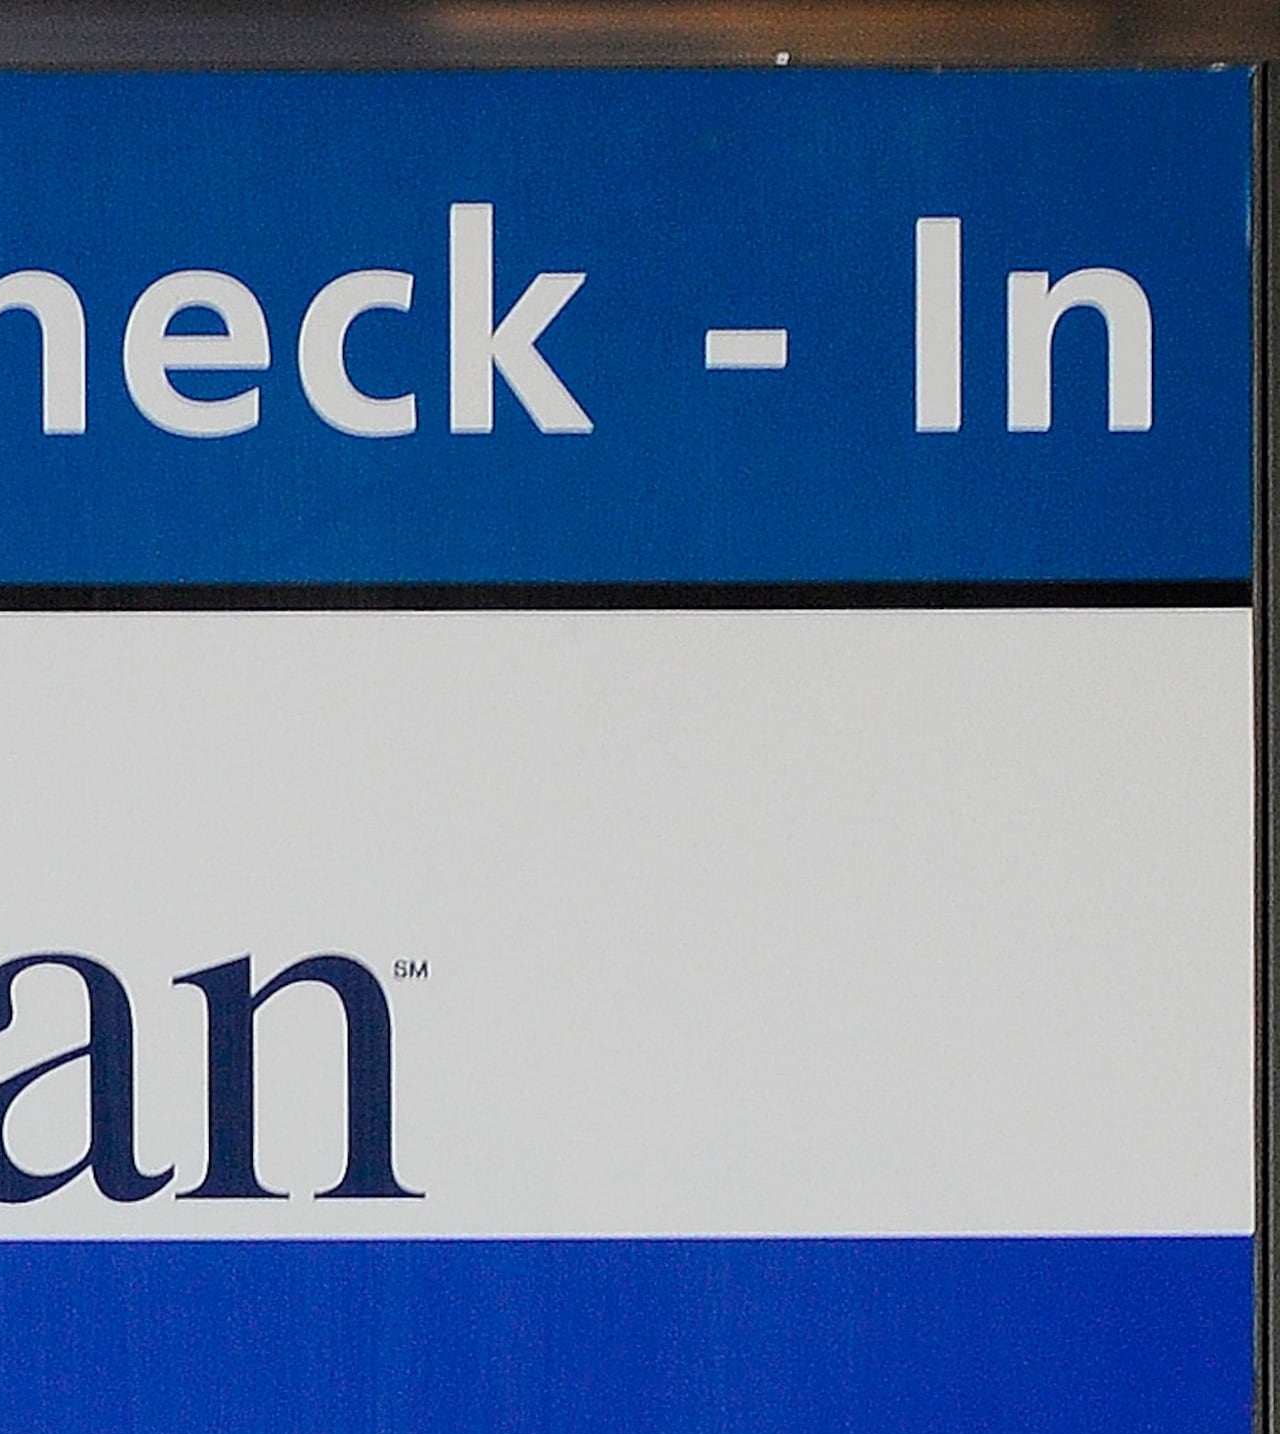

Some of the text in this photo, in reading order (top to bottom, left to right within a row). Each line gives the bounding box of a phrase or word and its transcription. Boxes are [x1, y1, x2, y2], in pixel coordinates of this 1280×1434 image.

[705, 329, 788, 369] -
[915, 217, 1154, 433] In
[392, 958, 430, 980] SM
